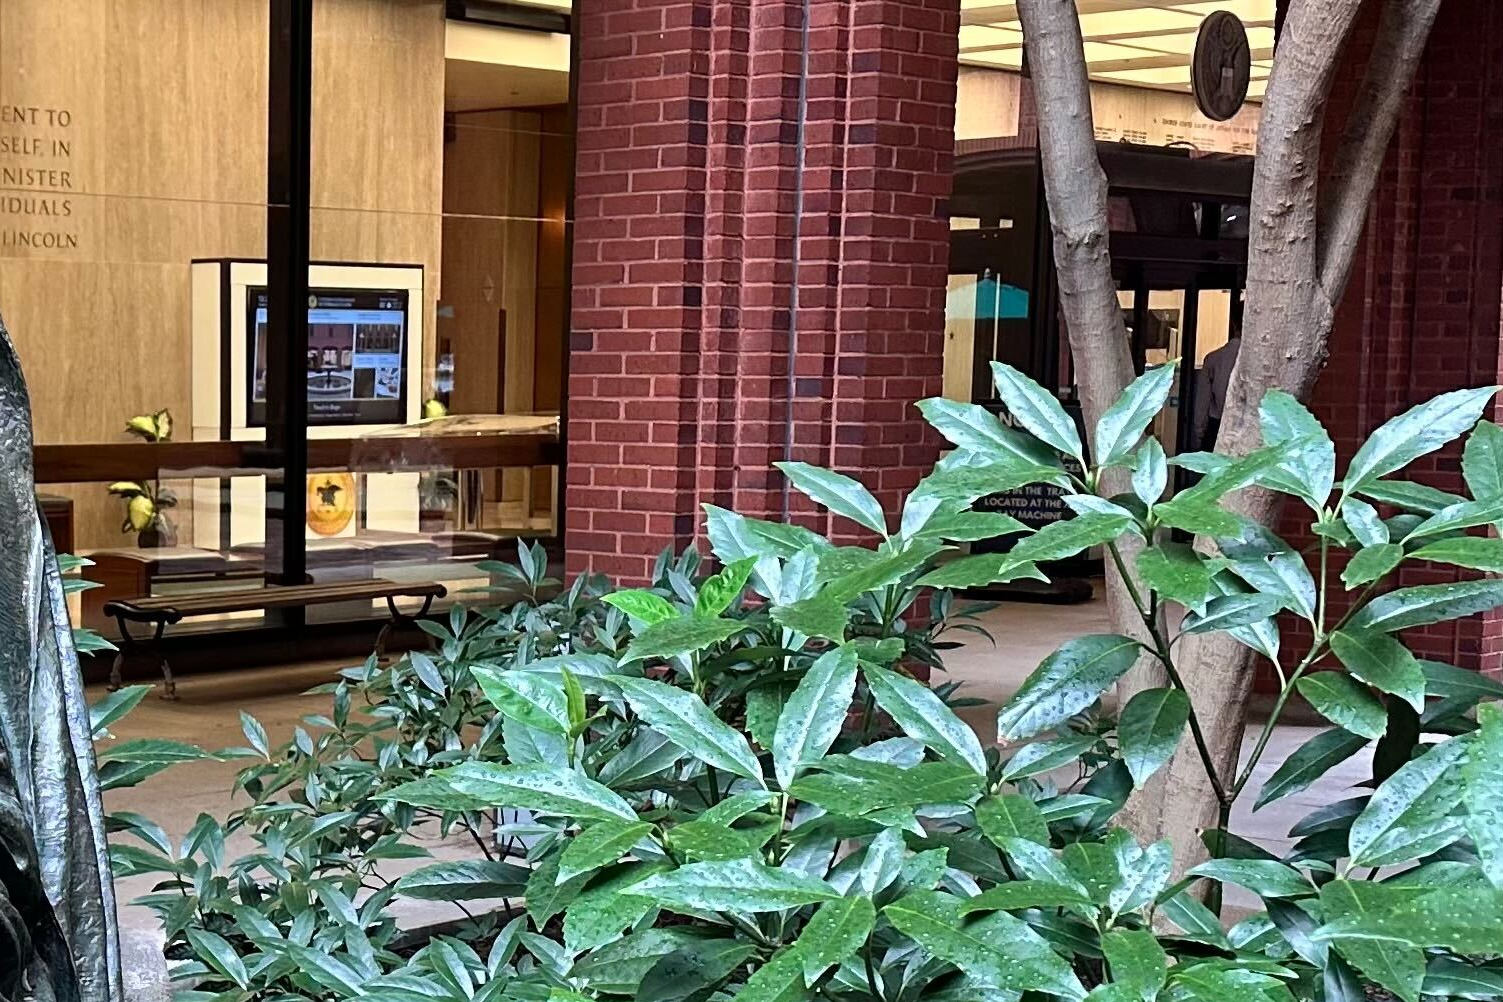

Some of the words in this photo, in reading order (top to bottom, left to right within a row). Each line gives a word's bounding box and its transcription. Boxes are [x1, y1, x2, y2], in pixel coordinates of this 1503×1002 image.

[45, 109, 71, 127] TO
[52, 140, 71, 157] IN
[2, 229, 78, 249] LINCOLN
[1025, 486, 1043, 495] THE
[984, 497, 1028, 507] LOCATED
[1030, 499, 1043, 508] AT
[1044, 500, 1063, 508] THE
[1018, 511, 1064, 519] MACHINE
